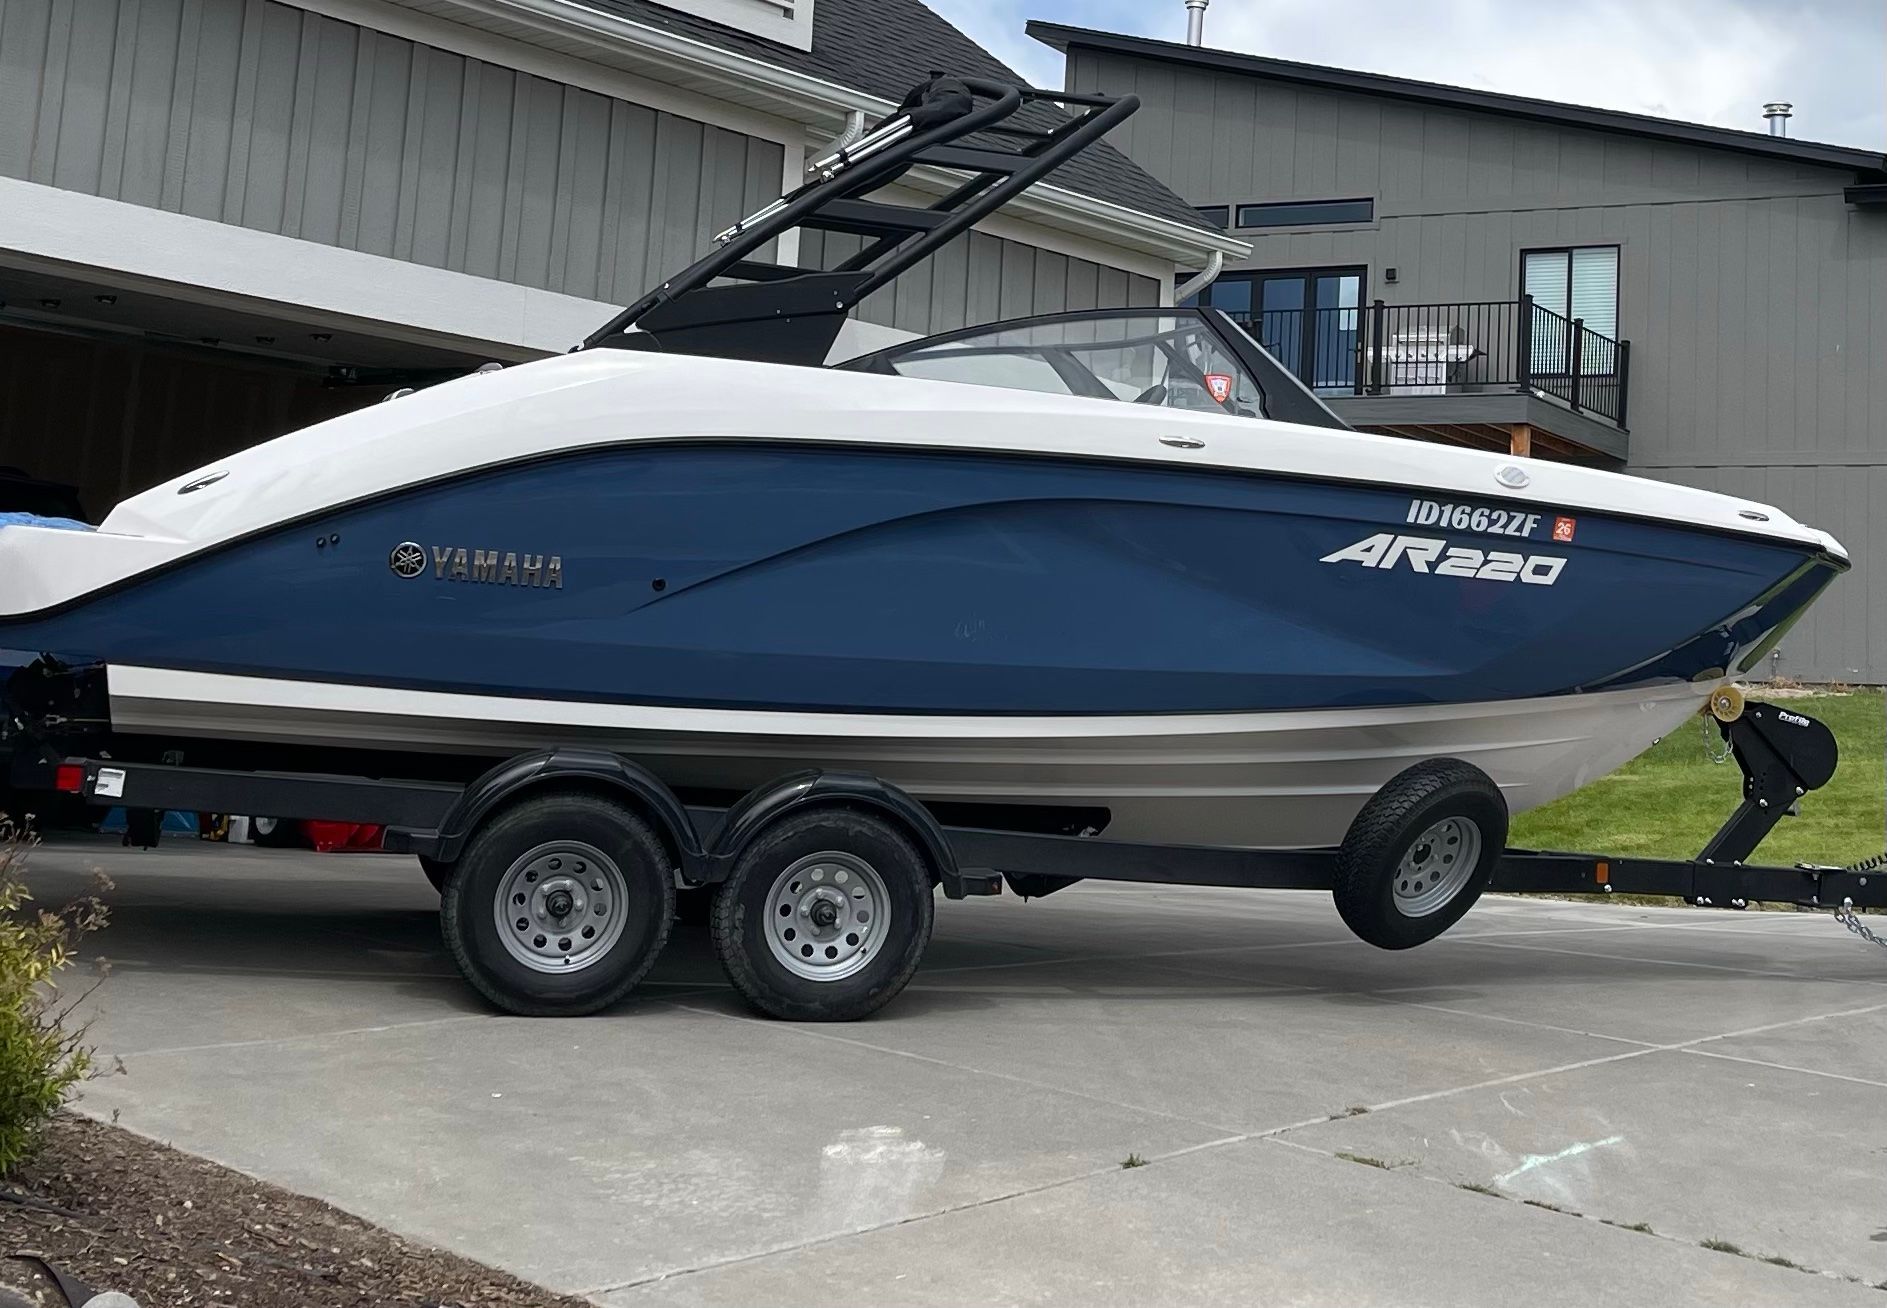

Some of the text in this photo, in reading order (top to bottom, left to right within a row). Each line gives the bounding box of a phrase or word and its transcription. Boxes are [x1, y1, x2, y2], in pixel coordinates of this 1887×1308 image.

[1406, 499, 1542, 537] ID1662ZF
[1555, 521, 1571, 535] 26
[431, 546, 563, 589] YAMAHA
[1319, 533, 1568, 585] AR220
